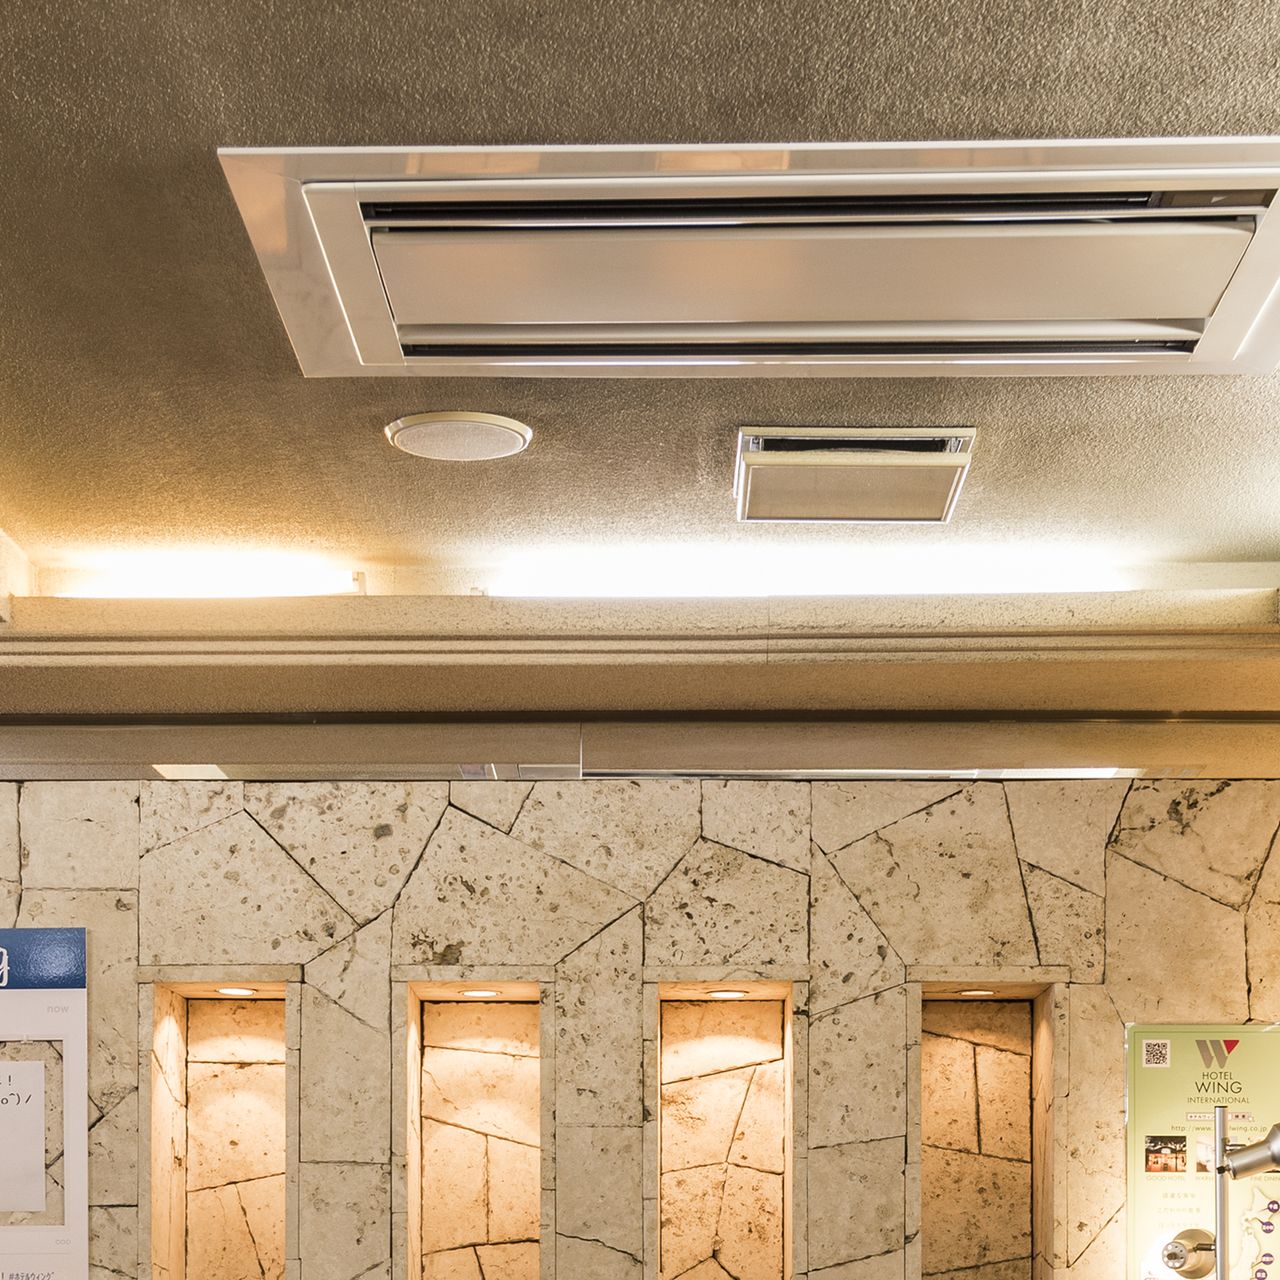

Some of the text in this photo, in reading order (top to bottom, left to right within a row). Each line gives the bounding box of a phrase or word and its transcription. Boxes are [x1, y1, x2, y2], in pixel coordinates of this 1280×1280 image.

[47, 1005, 69, 1014] now
[1202, 1071, 1233, 1080] HOTEL
[1195, 1081, 1243, 1094] WING
